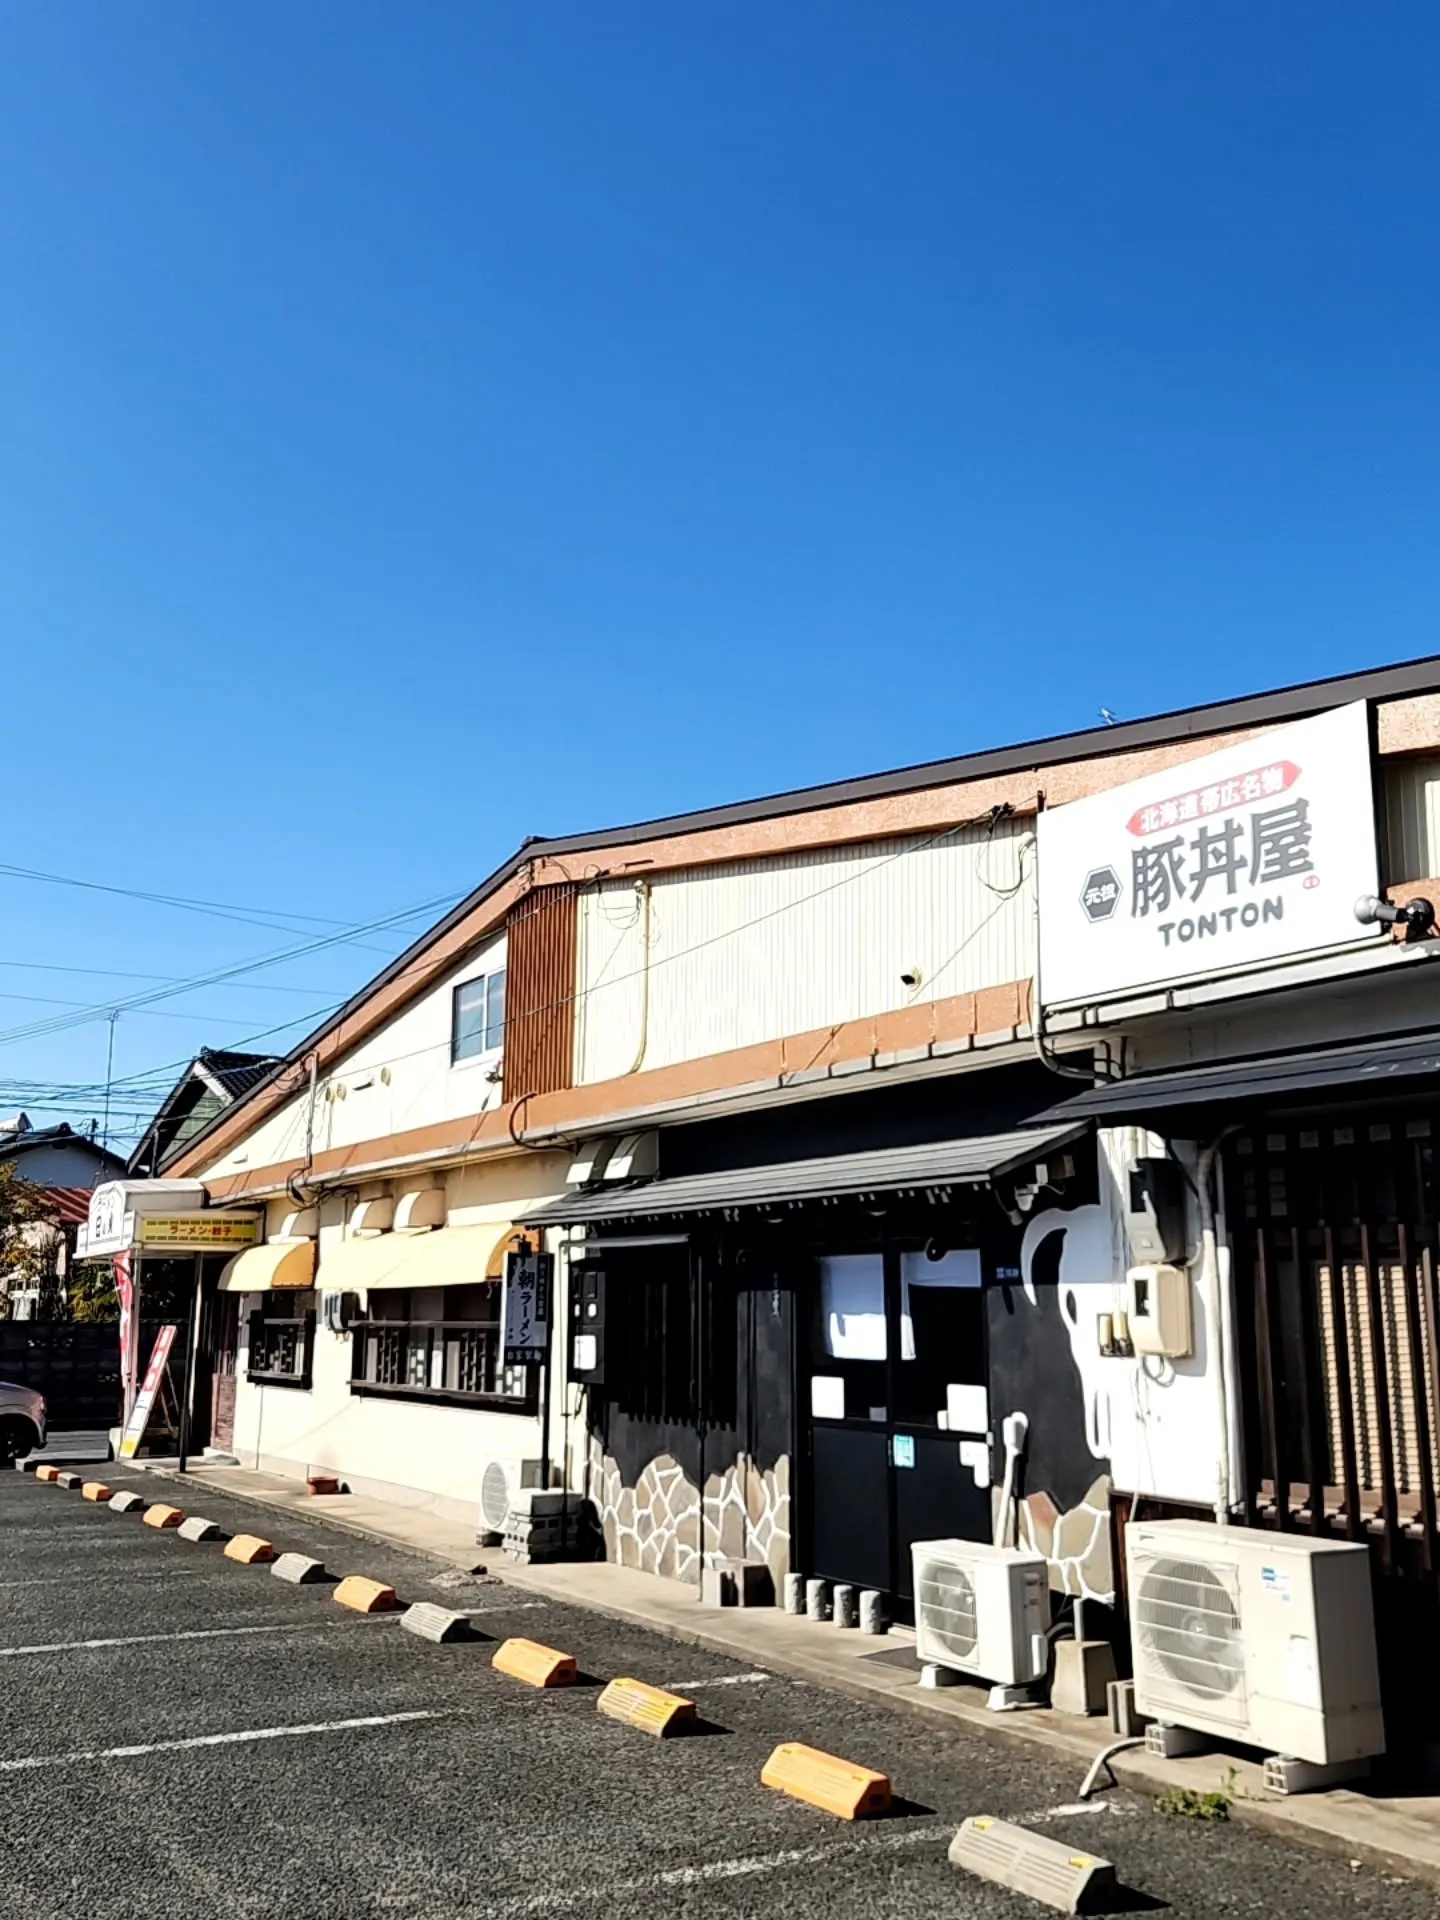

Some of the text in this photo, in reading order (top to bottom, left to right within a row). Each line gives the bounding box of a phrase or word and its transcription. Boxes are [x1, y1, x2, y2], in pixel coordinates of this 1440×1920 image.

[1131, 797, 1315, 918] 豚丼屋
[1085, 883, 1117, 906] 元祖
[1157, 895, 1284, 947] TONTON
[518, 1269, 536, 1345] 朝ラーメン
